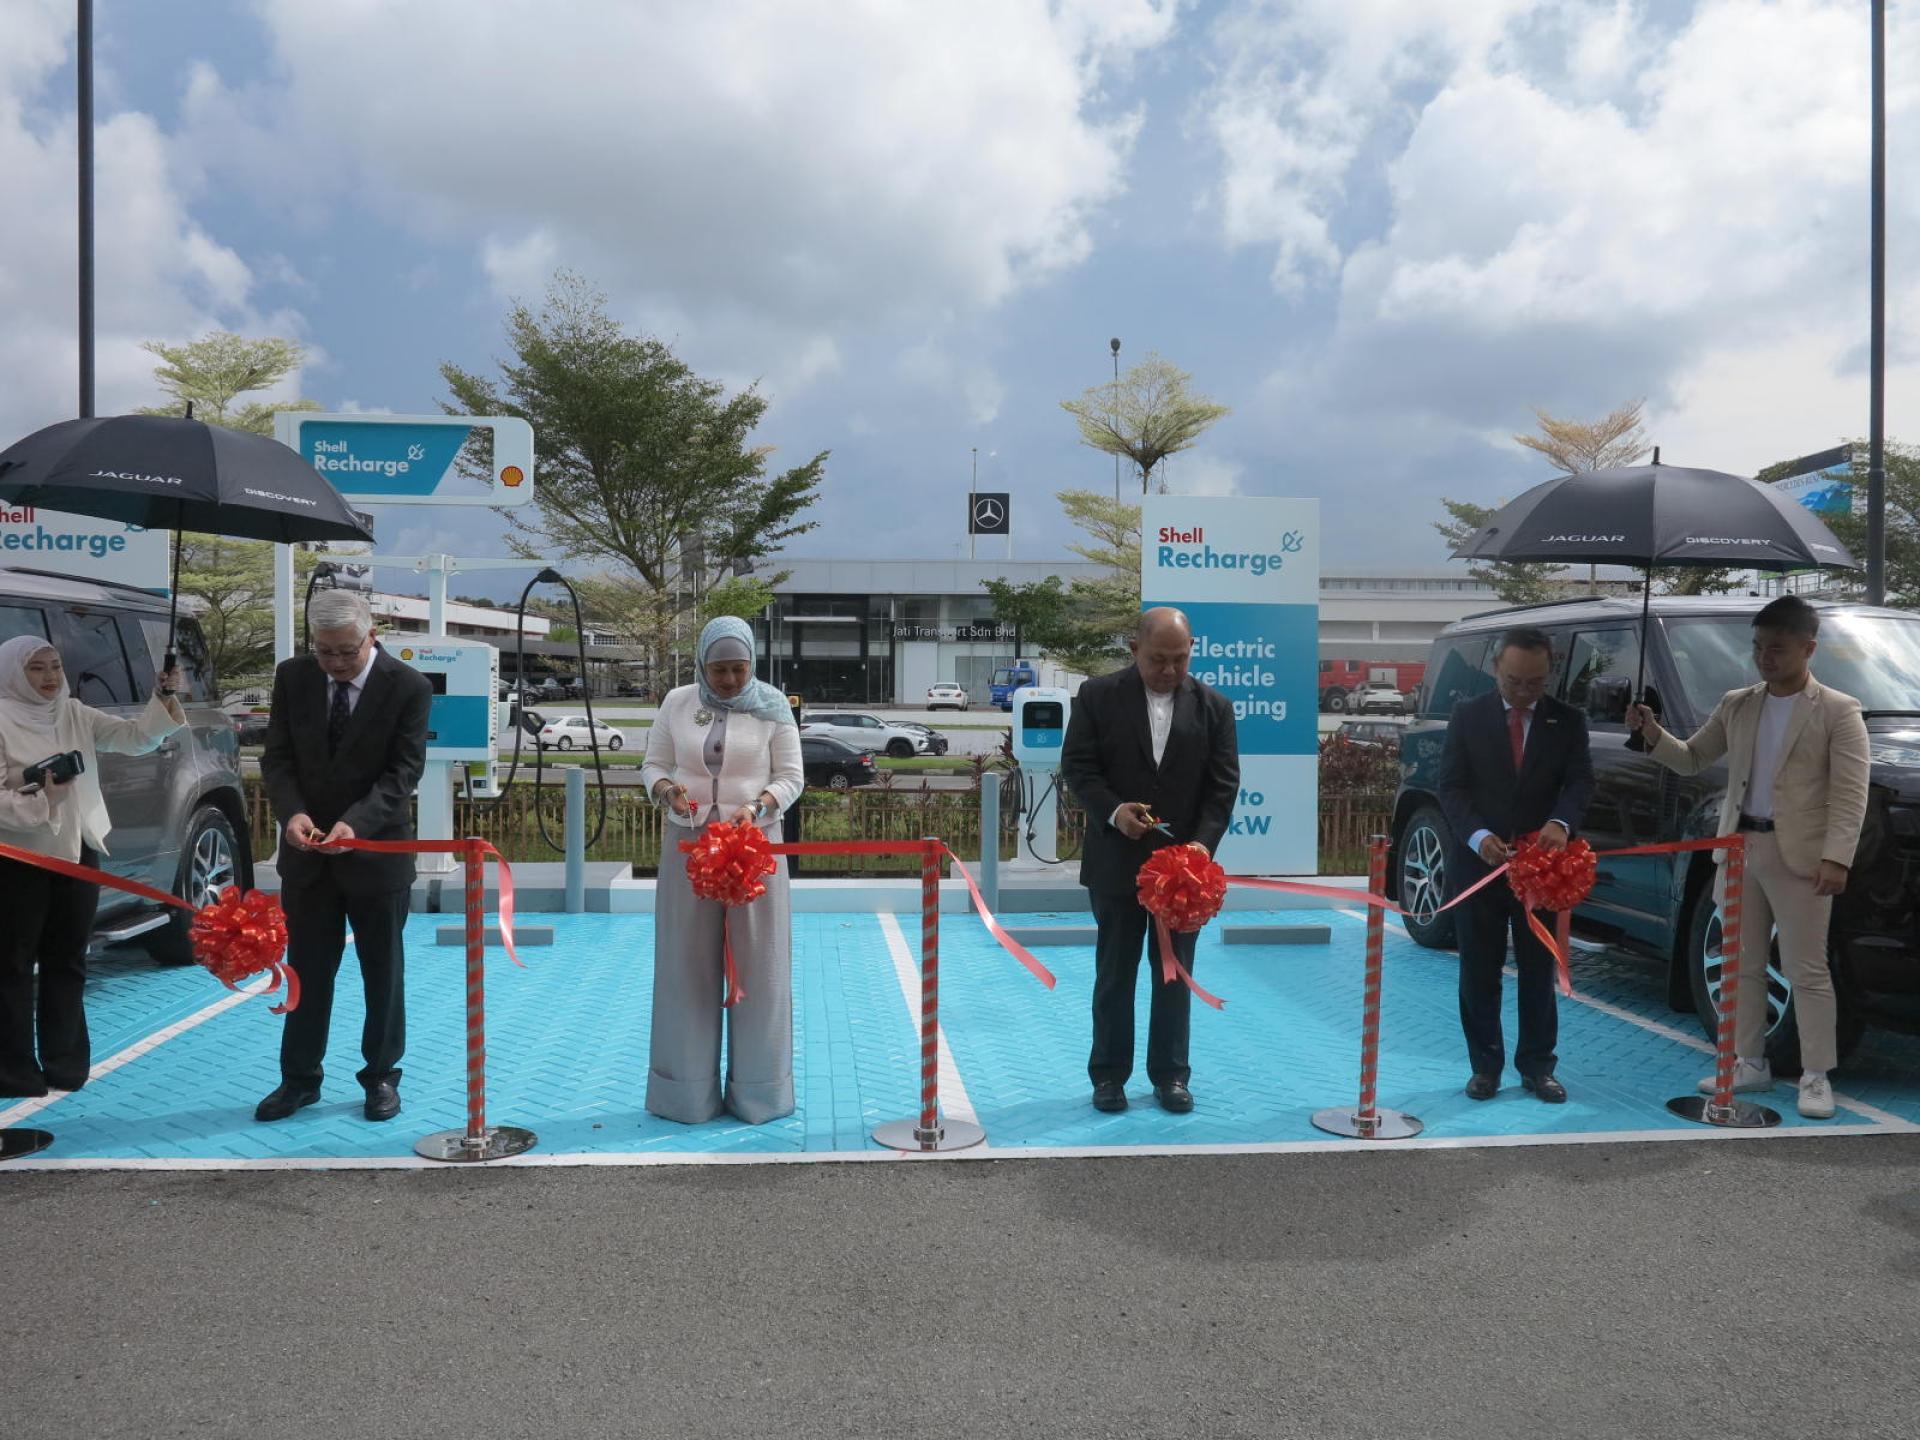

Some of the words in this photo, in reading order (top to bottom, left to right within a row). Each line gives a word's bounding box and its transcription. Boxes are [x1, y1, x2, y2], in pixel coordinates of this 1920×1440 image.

[314, 440, 348, 453] Shell
[314, 454, 410, 477] Recharge
[88, 469, 183, 485] JAGUAR
[243, 487, 318, 506] DISCOVERY
[0, 506, 35, 523] hell
[0, 525, 126, 558] echarge
[1158, 526, 1204, 544] Shell
[1541, 534, 1626, 543] JAGUAR
[1685, 536, 1772, 546] DISCOVERY
[1158, 545, 1283, 576] Recharge
[914, 625, 967, 639] Tranrt
[970, 625, 991, 637] Sdn
[995, 624, 1016, 637] Bhd
[1188, 635, 1276, 658] Electric
[1239, 788, 1265, 806] to
